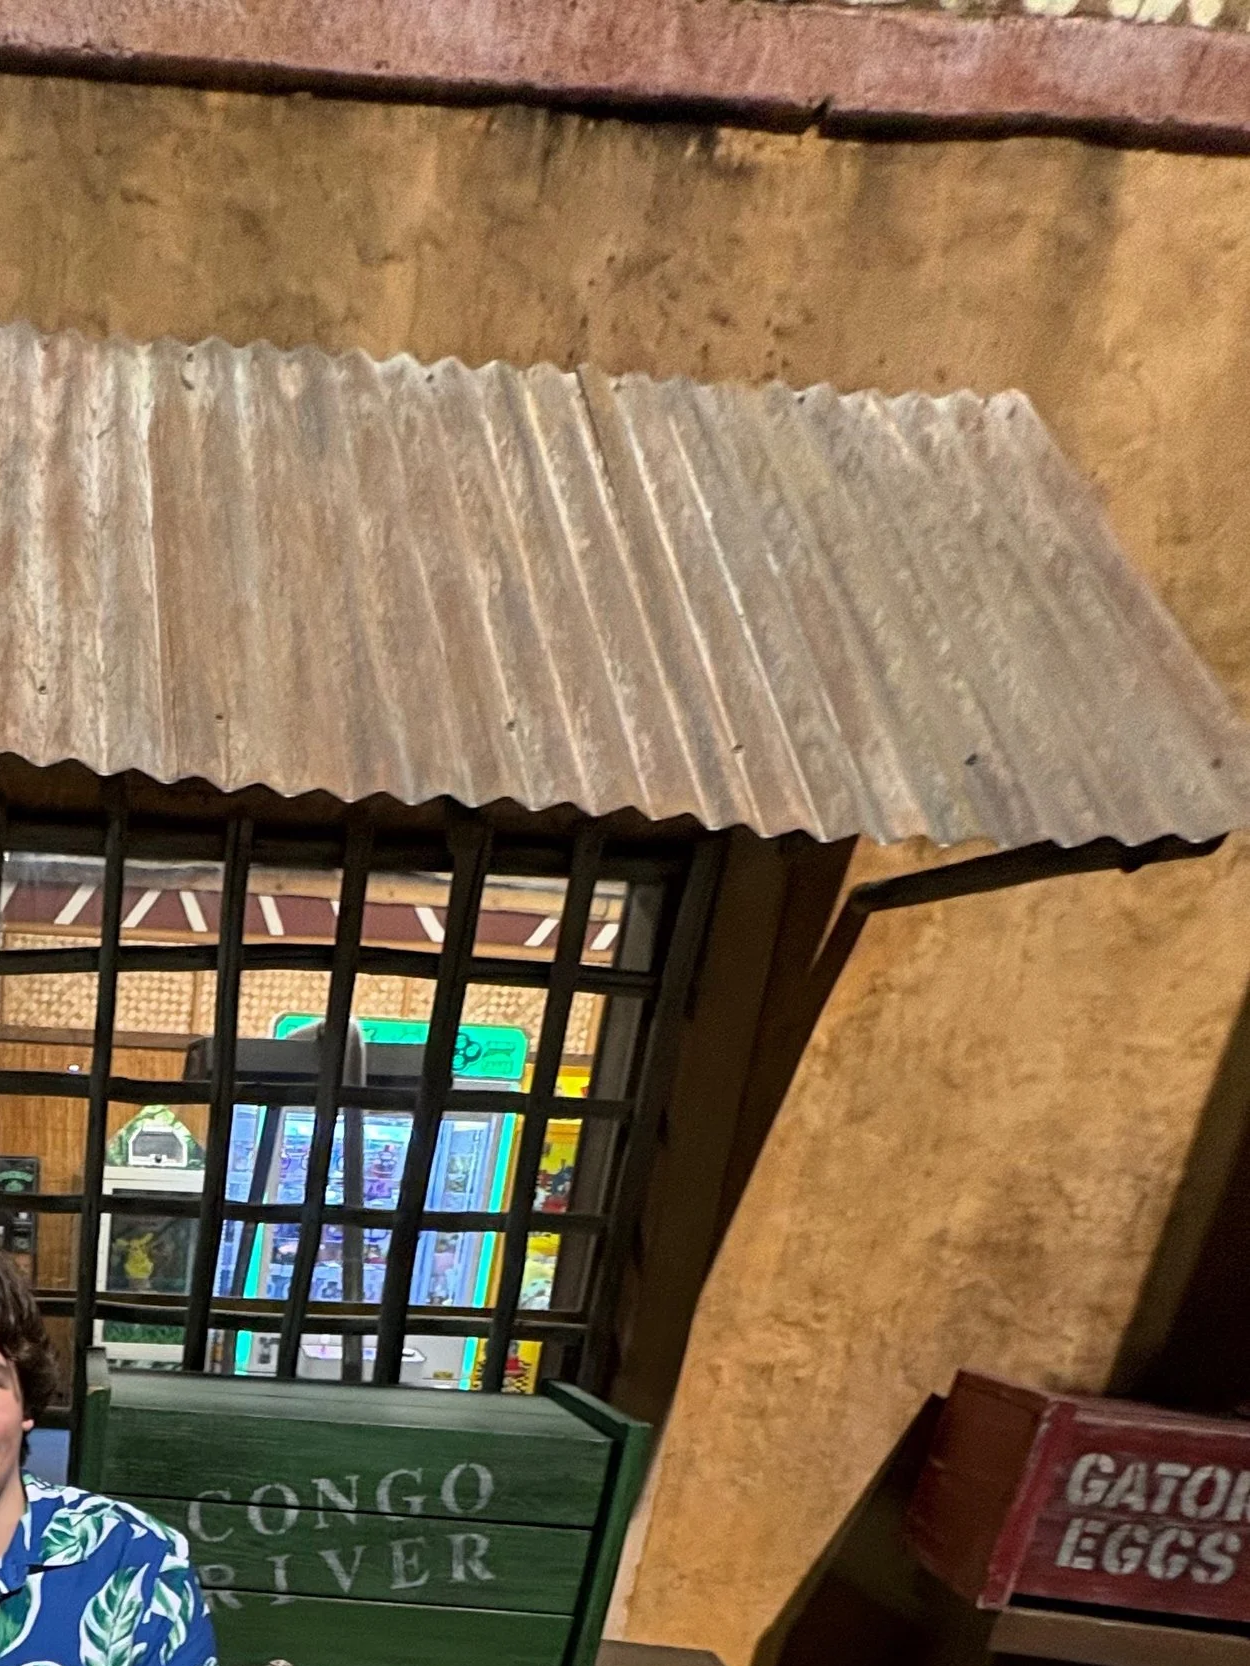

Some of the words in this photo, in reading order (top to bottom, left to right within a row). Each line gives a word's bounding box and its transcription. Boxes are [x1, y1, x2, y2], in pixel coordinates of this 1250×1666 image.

[187, 1462, 496, 1543] CONGO
[200, 1532, 497, 1610] RIVER
[1055, 1518, 1241, 1584] EGGS
